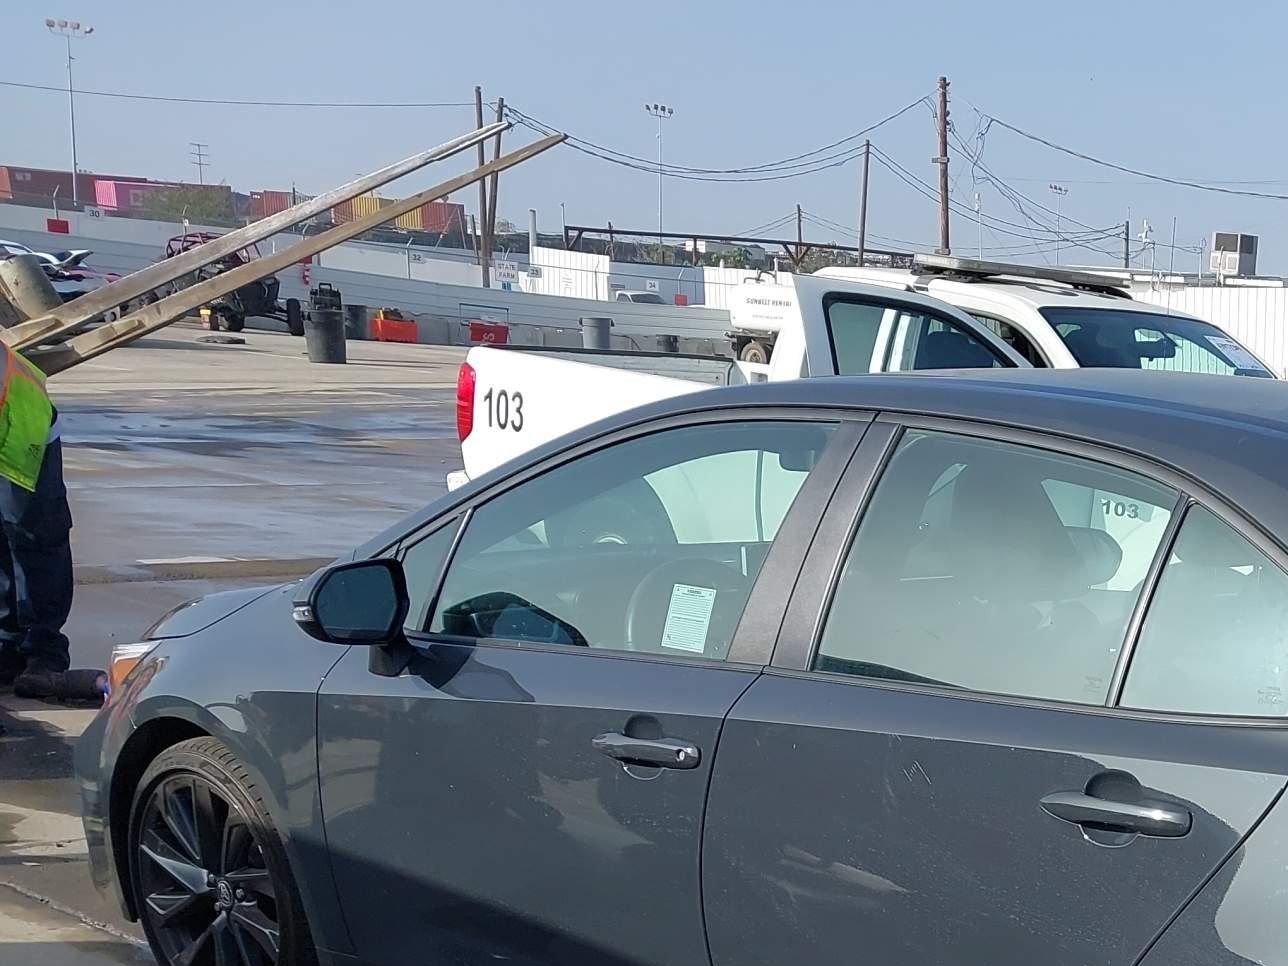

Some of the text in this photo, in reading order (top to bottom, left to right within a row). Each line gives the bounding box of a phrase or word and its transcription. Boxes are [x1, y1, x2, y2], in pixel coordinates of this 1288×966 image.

[89, 209, 100, 218] 30
[497, 262, 517, 271] STATE
[498, 271, 516, 279] FARM
[483, 386, 524, 433] 103
[1101, 500, 1140, 519] 103
